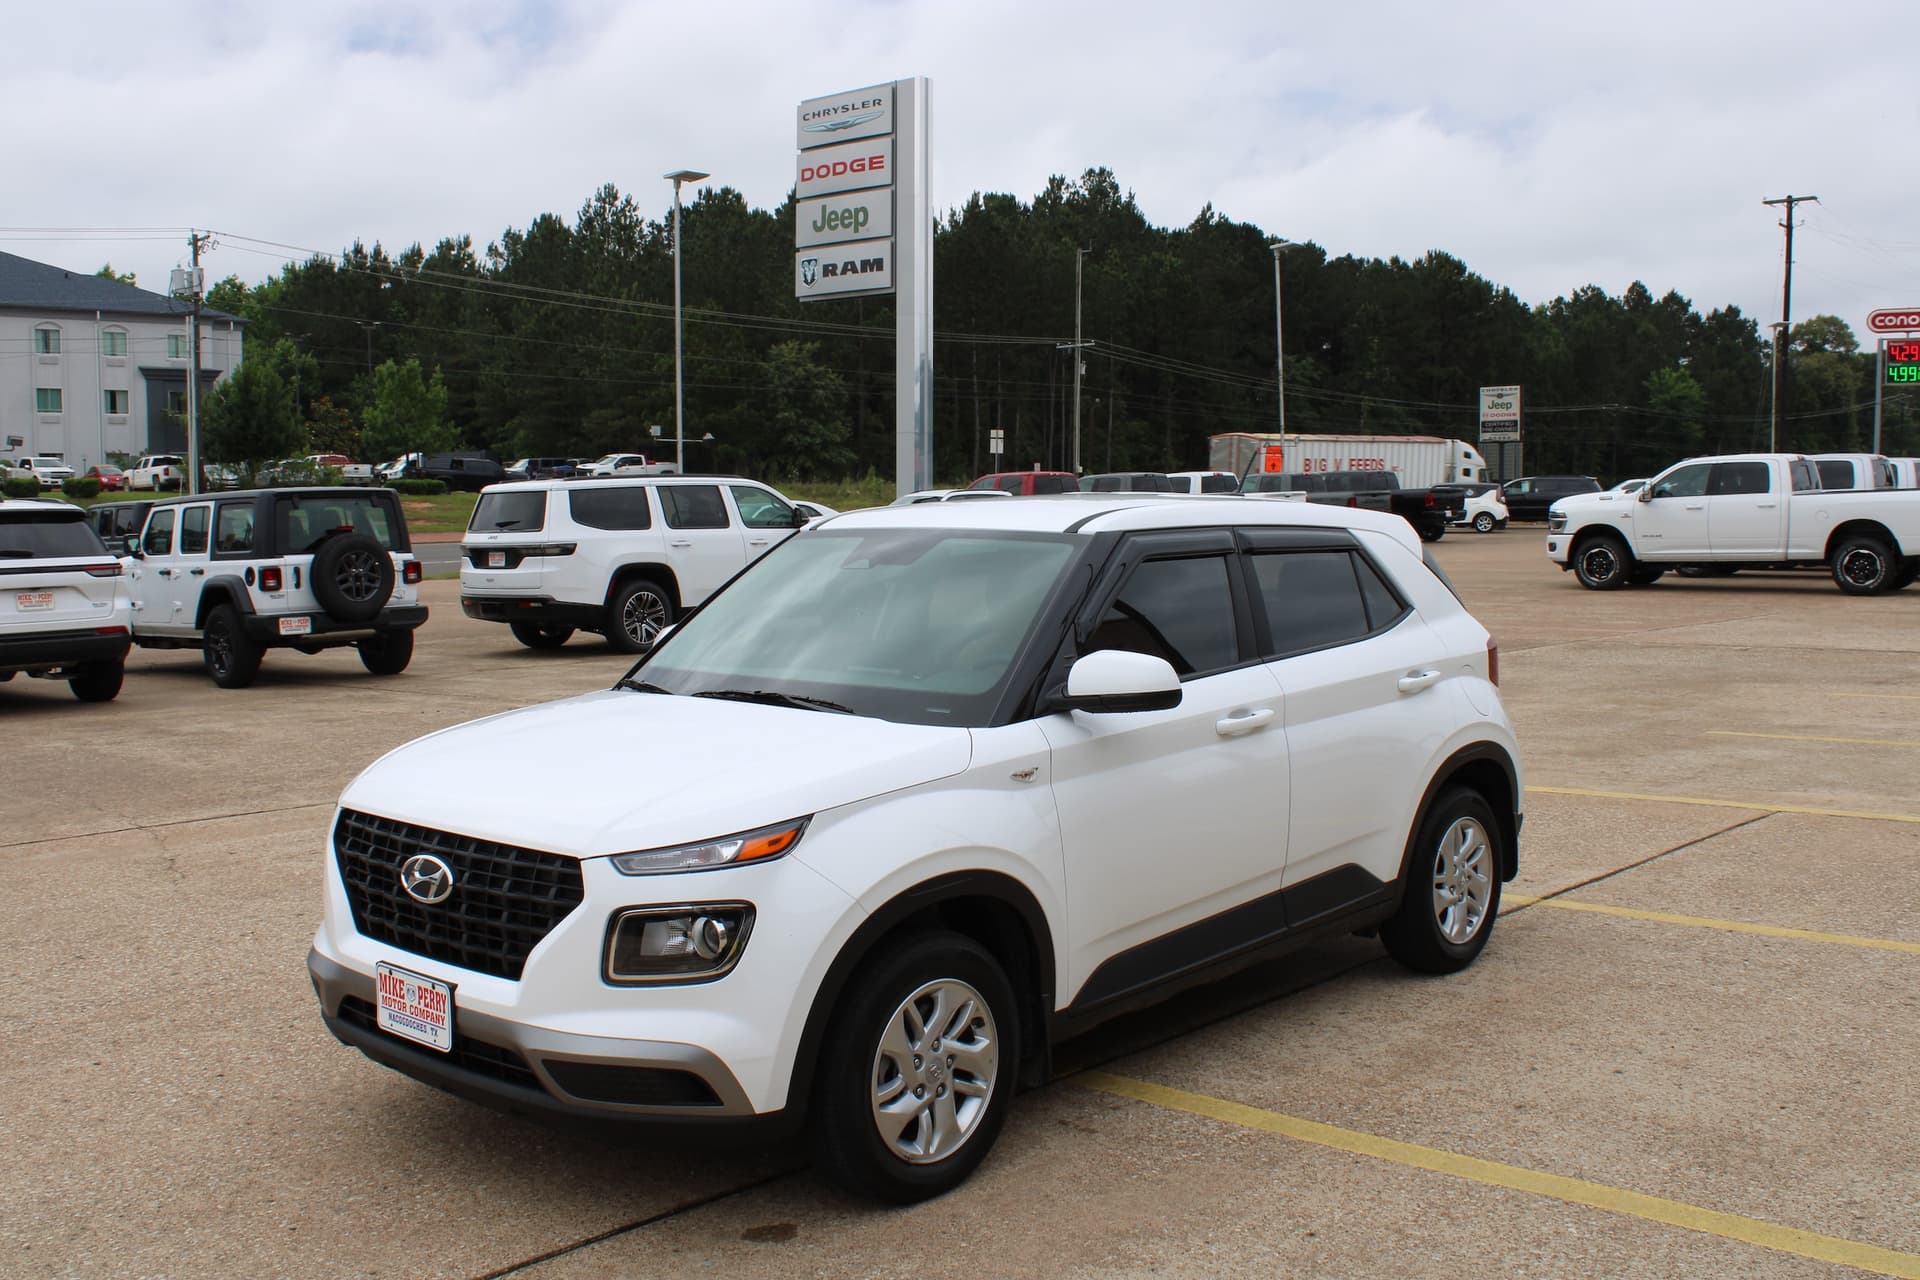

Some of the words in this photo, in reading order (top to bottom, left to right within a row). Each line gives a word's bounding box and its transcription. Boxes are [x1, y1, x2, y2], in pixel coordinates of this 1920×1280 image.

[802, 98, 883, 122] CHRYSLER
[800, 155, 885, 183] DODGE
[812, 204, 869, 233] Jeep
[822, 257, 884, 278] RAM
[1891, 345, 1919, 360] 4.29
[1488, 400, 1512, 411] Jeep
[1303, 458, 1328, 472] BIG
[1334, 458, 1342, 472] V
[1348, 458, 1385, 471] FEEDS
[379, 973, 405, 1000] MIKE
[417, 986, 446, 1014] PERRY
[381, 995, 407, 1012] MOTOR
[410, 1005, 445, 1026] COMPANY
[430, 1027, 439, 1038] TX
